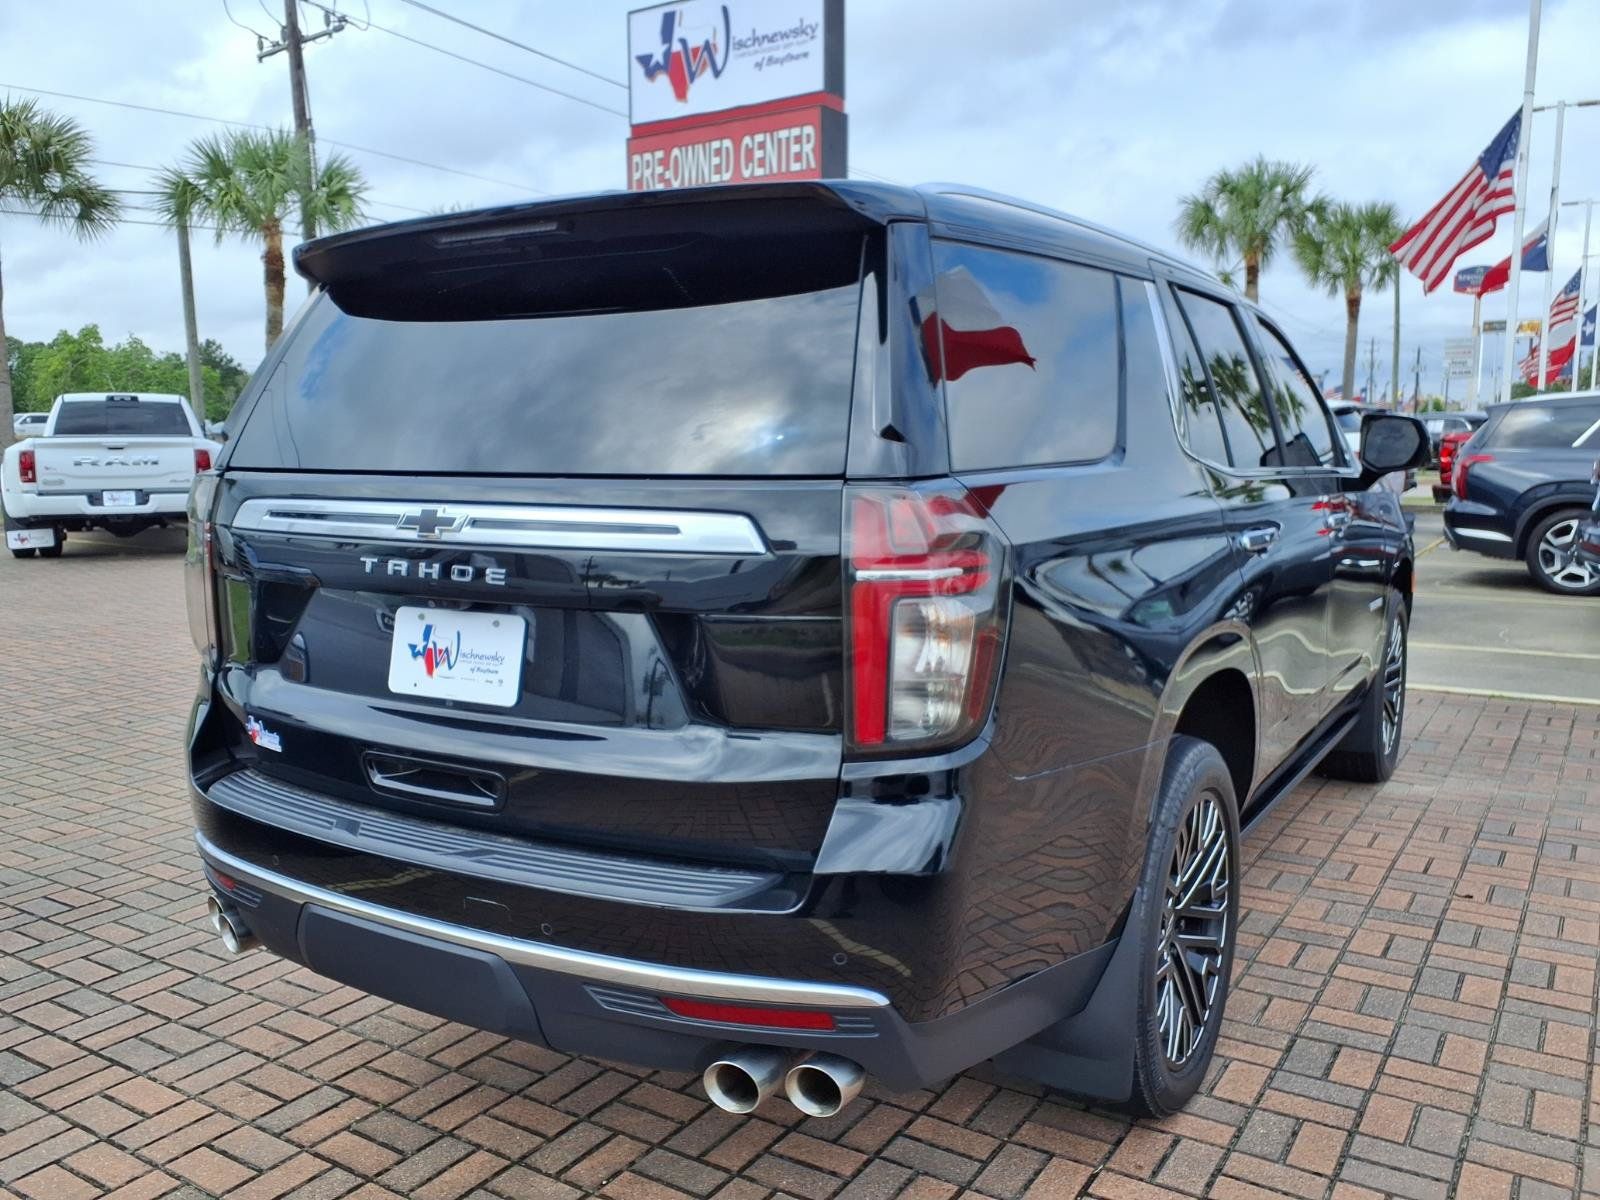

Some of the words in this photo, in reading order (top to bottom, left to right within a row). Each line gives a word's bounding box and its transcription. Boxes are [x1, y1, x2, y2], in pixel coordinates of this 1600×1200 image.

[632, 138, 734, 191] PRE-OWNED
[740, 125, 816, 178] CENTER
[360, 557, 506, 585] TAHOE
